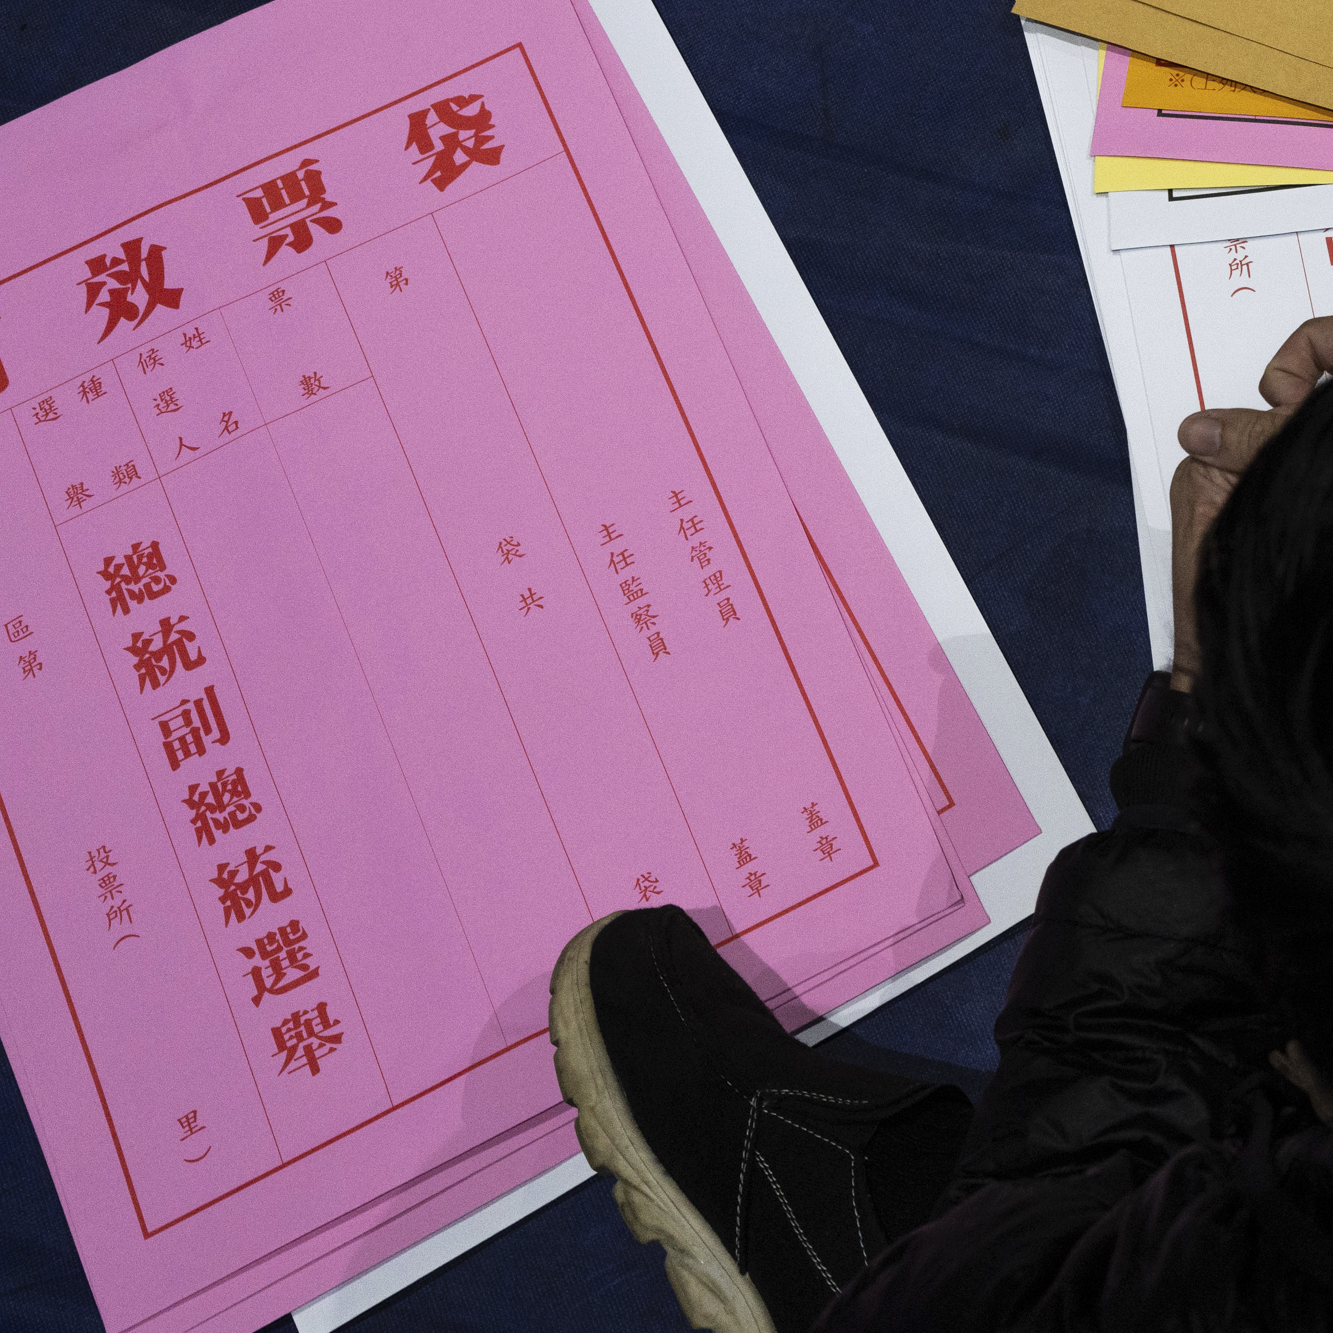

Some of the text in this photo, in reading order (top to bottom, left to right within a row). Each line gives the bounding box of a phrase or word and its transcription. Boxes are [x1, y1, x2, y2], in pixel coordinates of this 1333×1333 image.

[0, 93, 505, 394] 效票袋
[383, 266, 410, 294] 第
[180, 326, 240, 437] 姓名
[268, 287, 330, 399] 票數
[31, 395, 94, 509] 選舉
[78, 374, 142, 489] 種類
[137, 347, 200, 459] 候選人
[599, 523, 671, 662] 主任監察員
[669, 490, 741, 627] 主任管理員
[3, 614, 43, 679] 區第
[97, 540, 344, 1077] 總統副總統選舉
[801, 801, 841, 862] 蓋章
[633, 871, 664, 905] 袋
[730, 837, 770, 898] 蓋章
